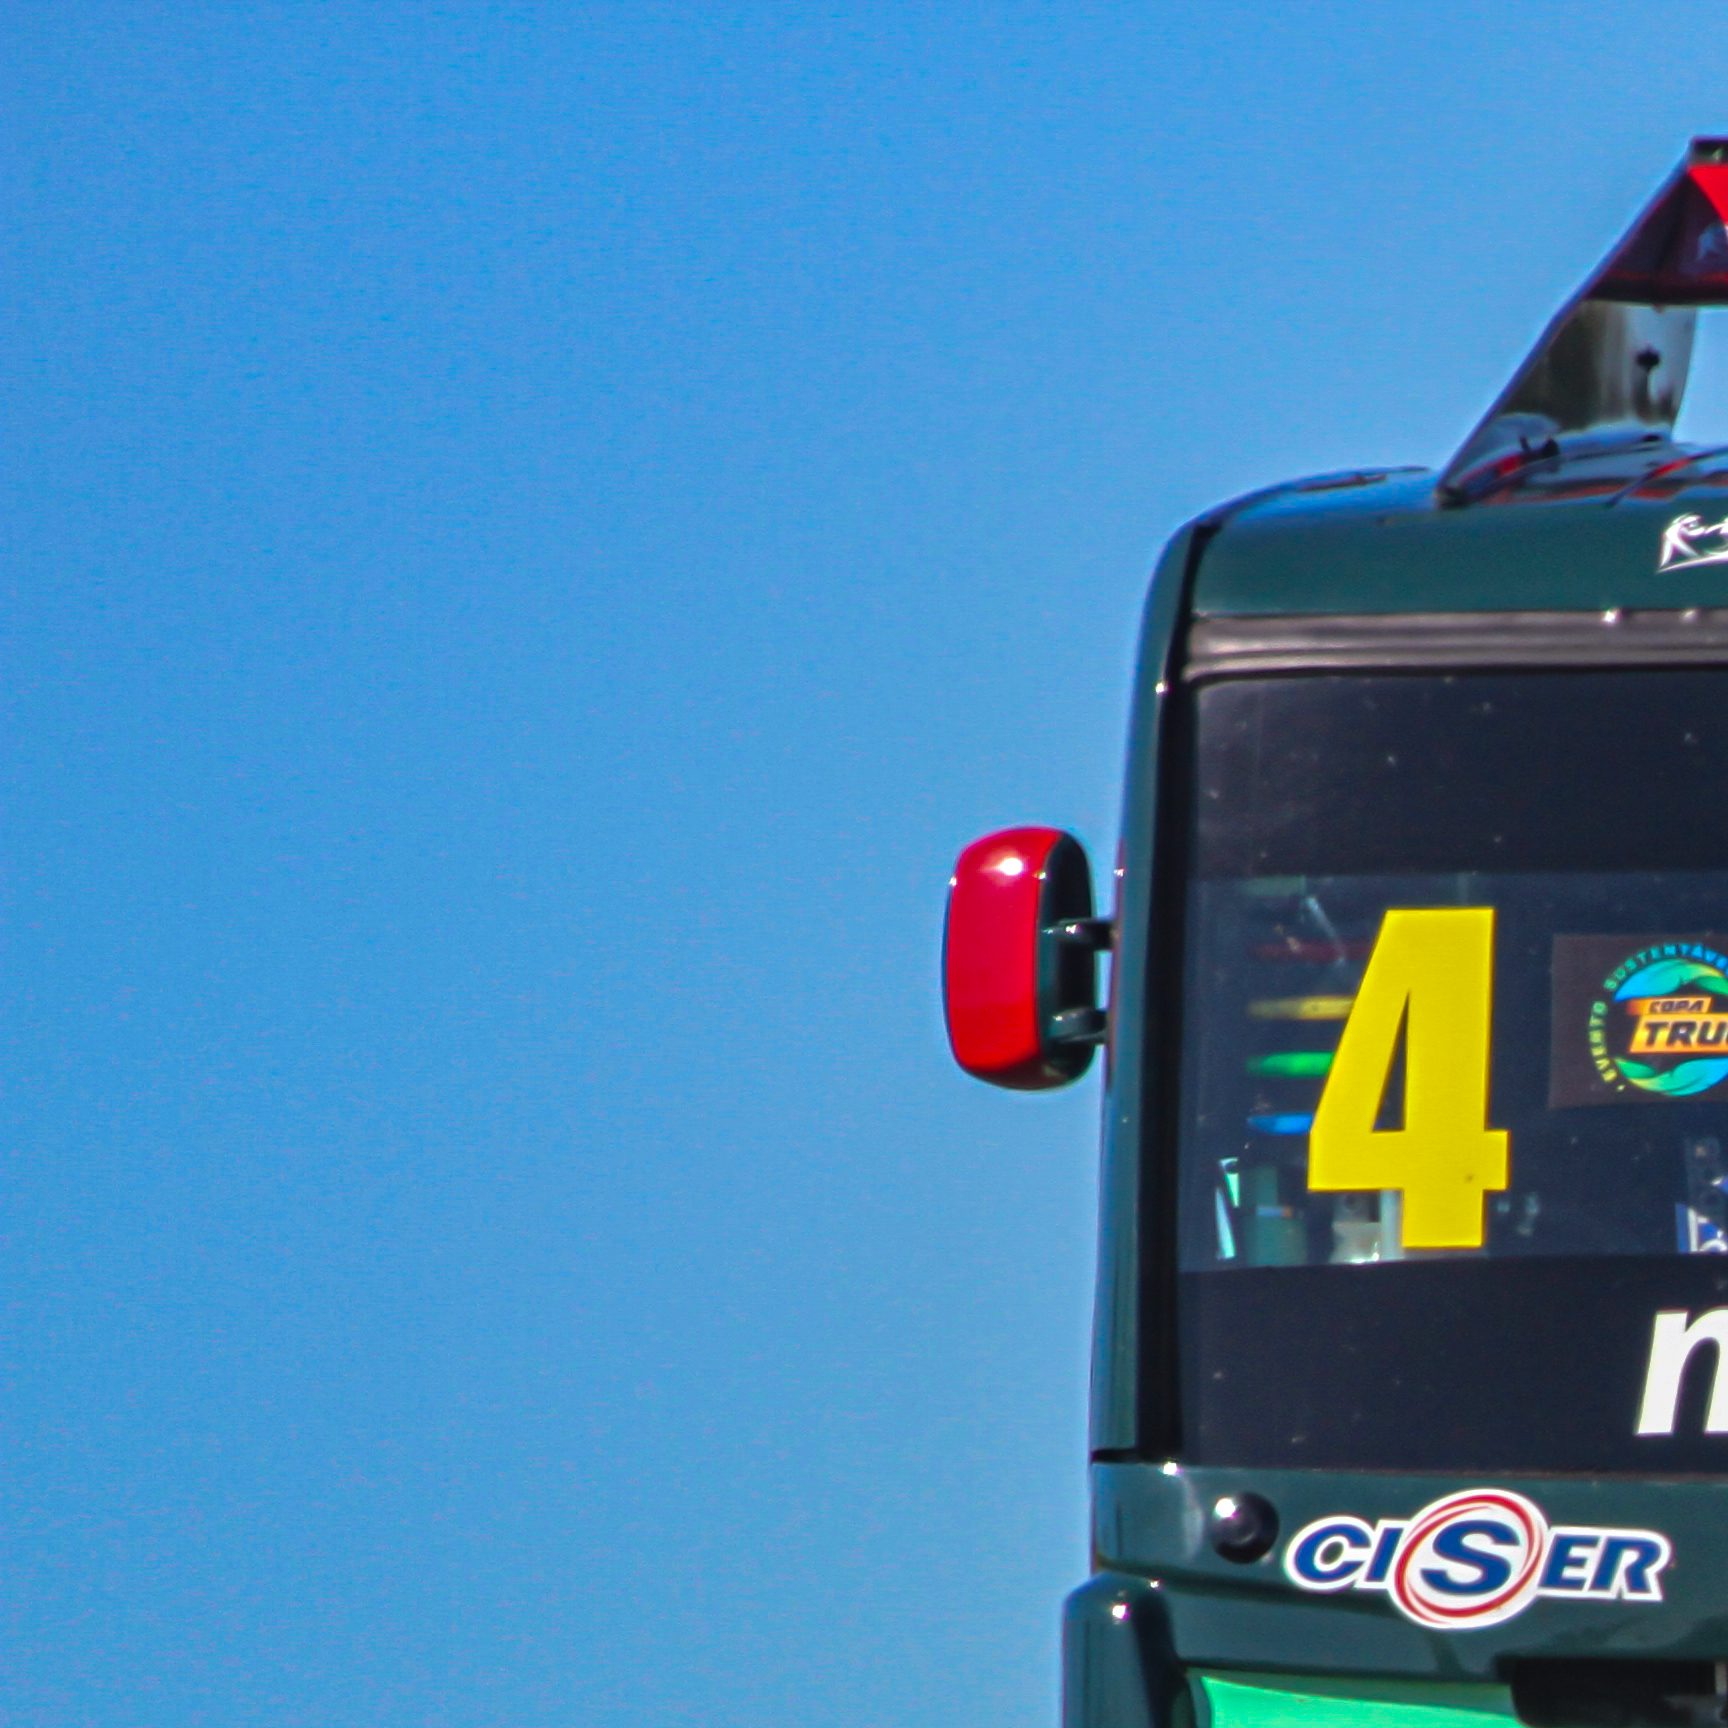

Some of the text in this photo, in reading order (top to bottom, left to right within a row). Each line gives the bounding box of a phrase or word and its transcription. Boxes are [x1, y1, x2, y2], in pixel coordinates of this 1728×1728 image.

[1649, 999, 1705, 1013] COPA
[1308, 908, 1510, 1248] 4
[1287, 1512, 1670, 1600] CISER
